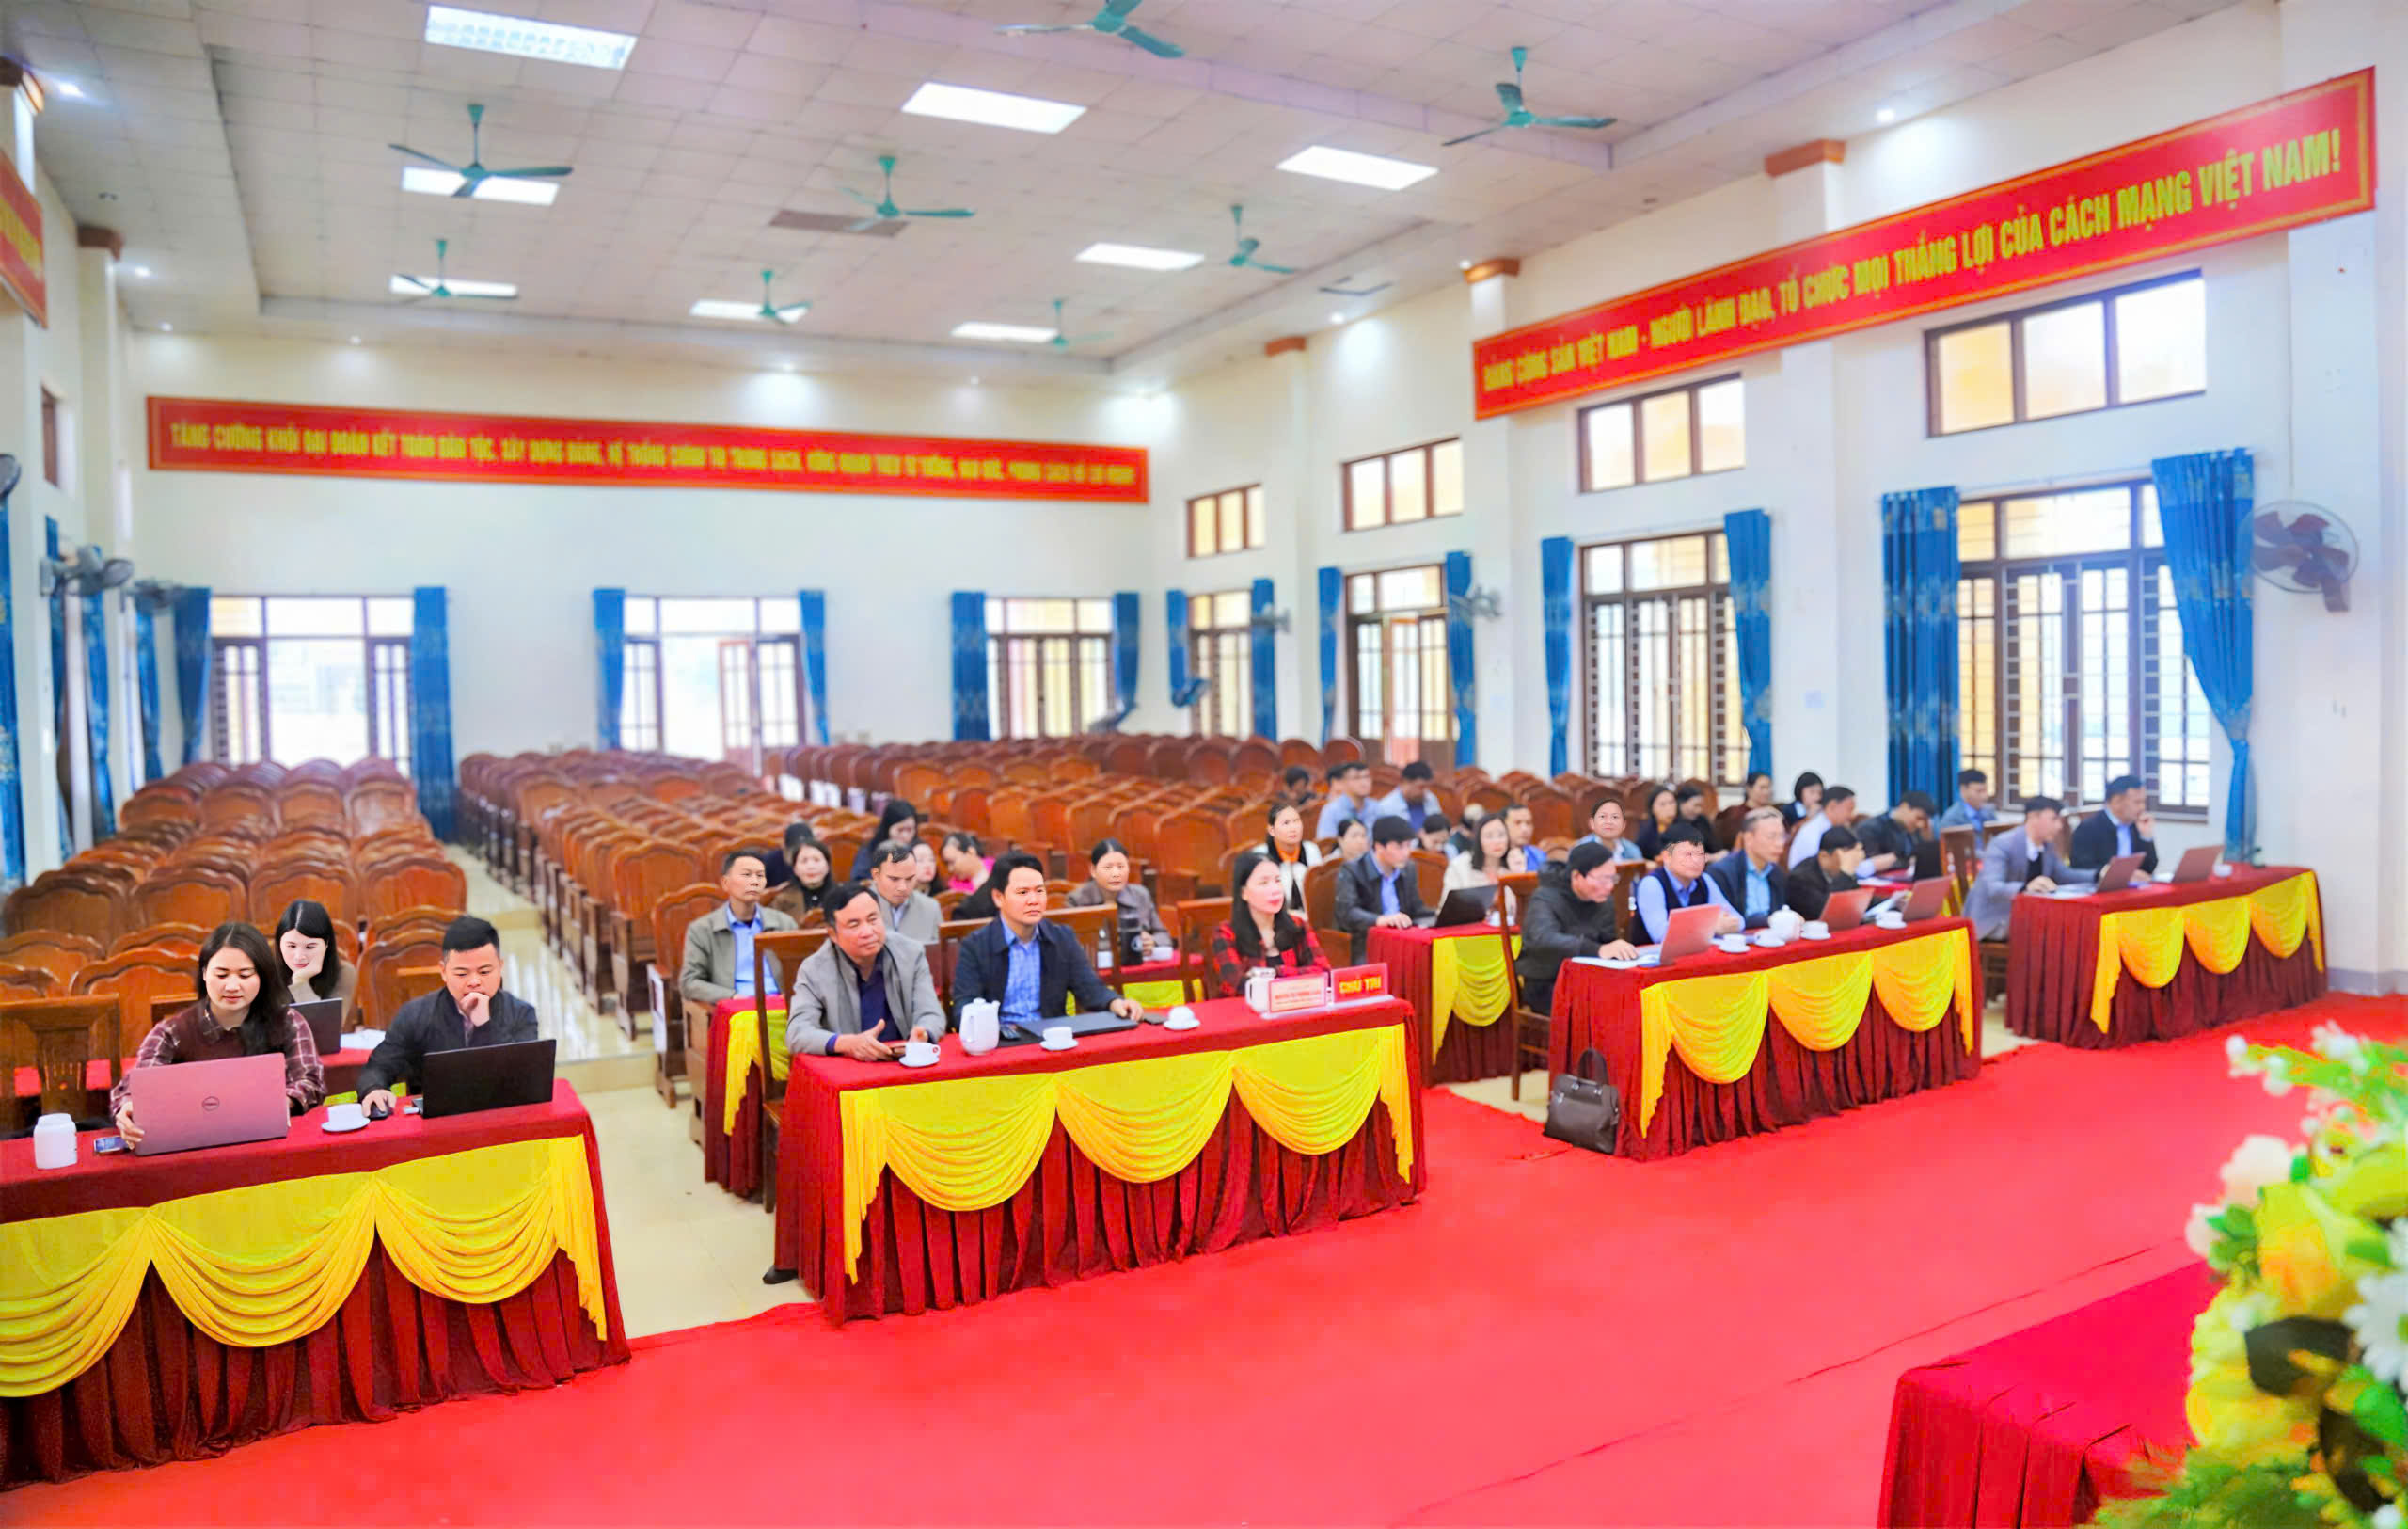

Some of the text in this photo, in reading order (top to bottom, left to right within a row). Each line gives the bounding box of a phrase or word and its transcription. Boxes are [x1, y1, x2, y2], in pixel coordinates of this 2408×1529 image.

[1577, 330, 1606, 372] VIỆT
[1697, 295, 1736, 336] LÃNH
[1778, 268, 1800, 312] TỔ
[1803, 263, 1849, 308] CHỨC
[1854, 255, 1890, 298] MỌI
[1894, 231, 1957, 286] THẮNG
[1962, 225, 1995, 273] LỢI
[2000, 203, 2044, 259] CỦA
[2049, 191, 2111, 247] CÁCH
[2117, 169, 2192, 232] MẠNG
[2197, 149, 2253, 209] VIỆT
[2262, 128, 2341, 191] NAM!
[1339, 974, 1363, 995] CHỦ
